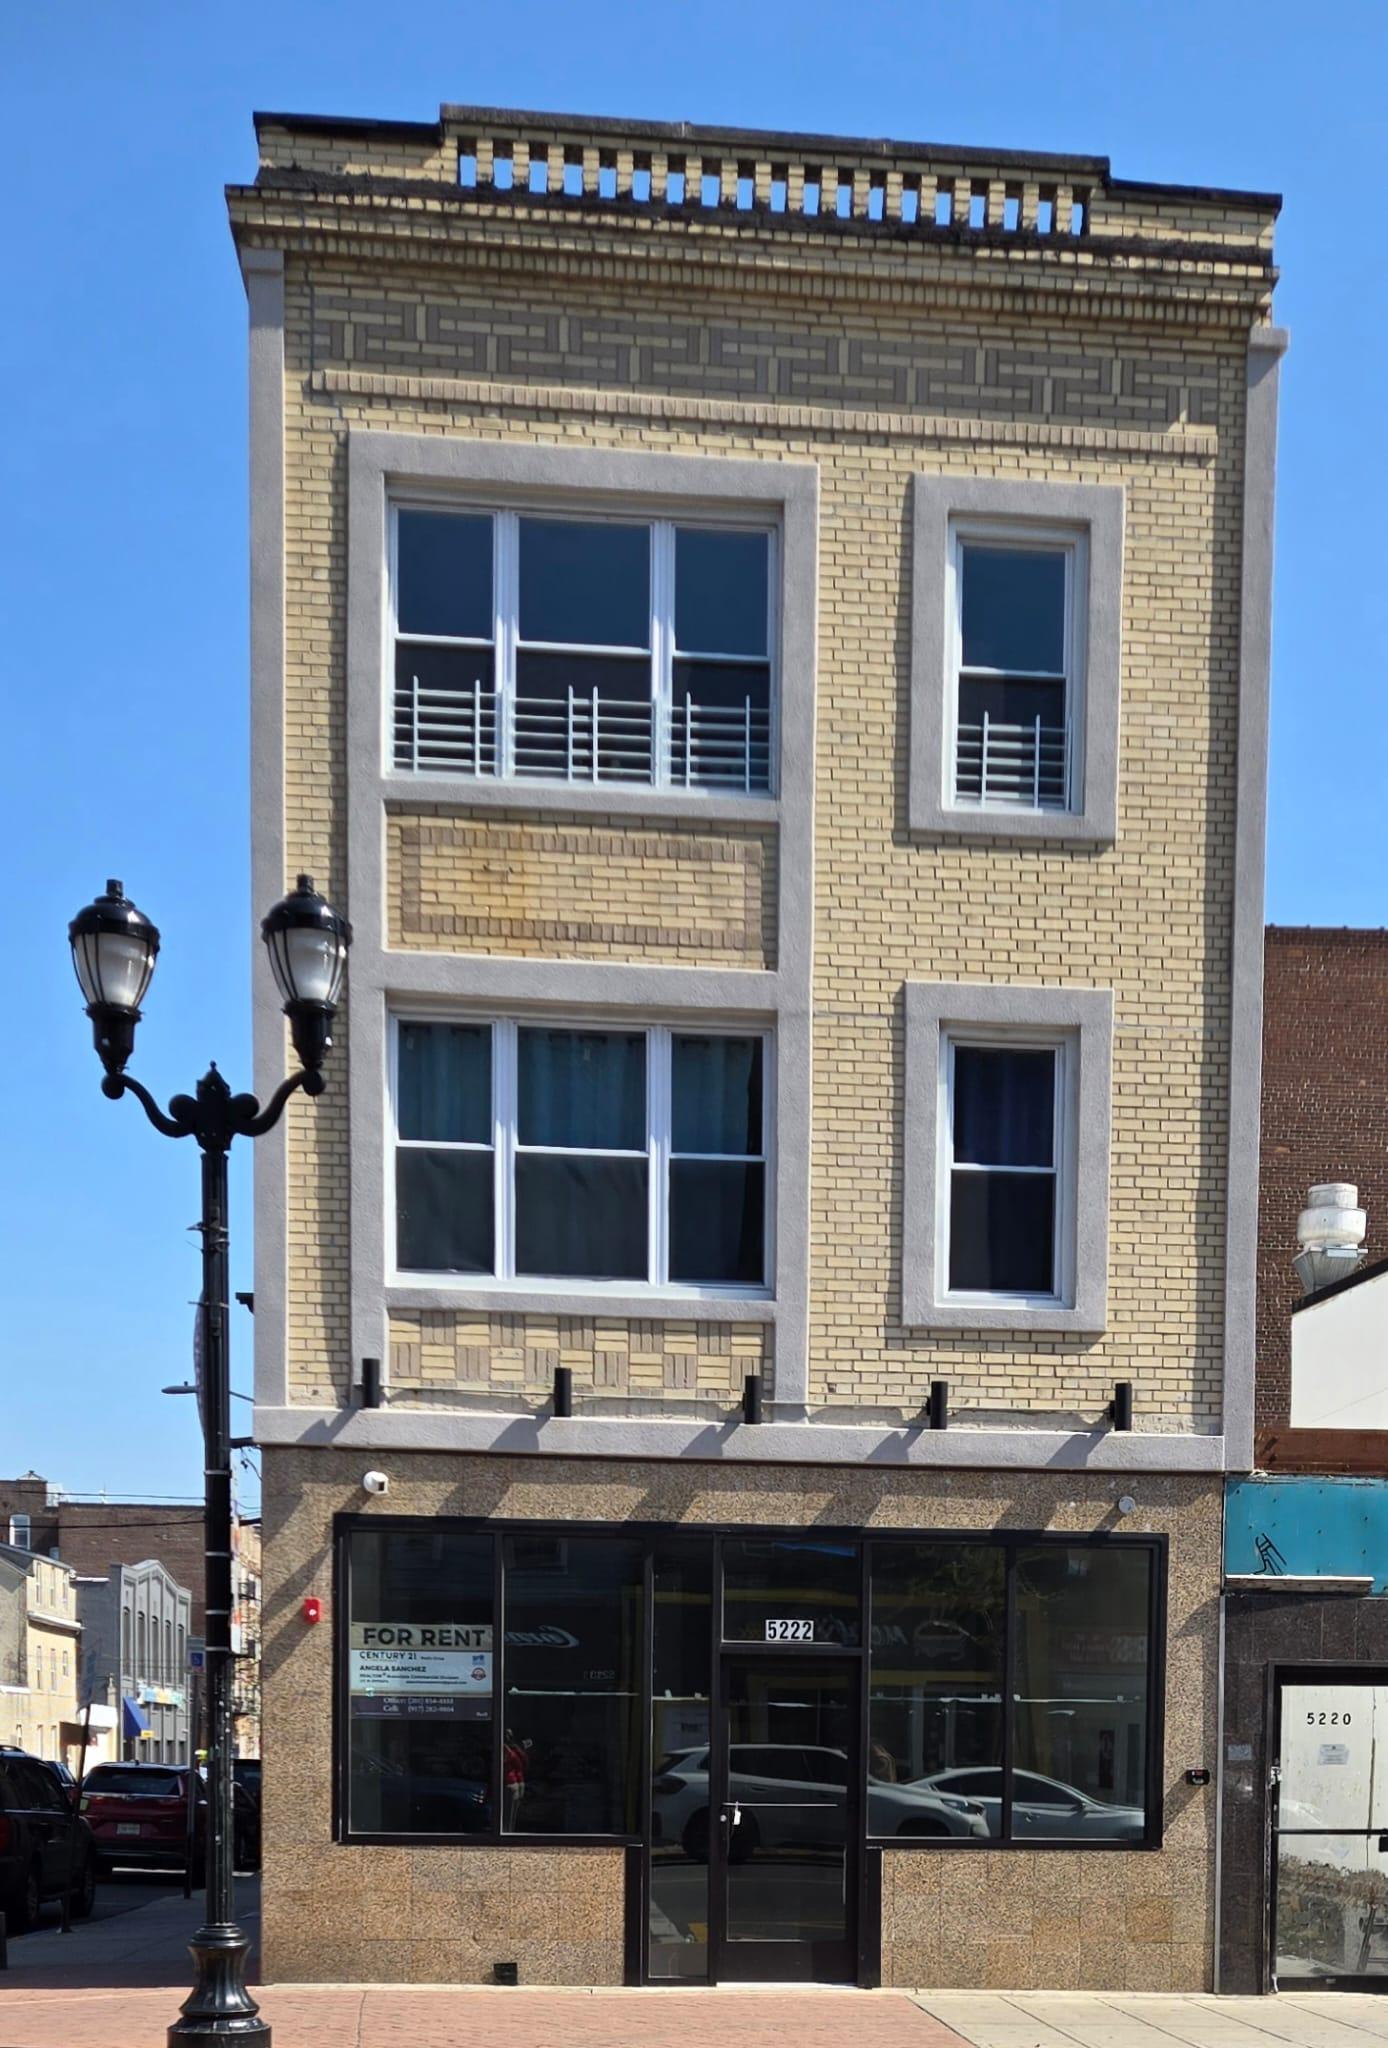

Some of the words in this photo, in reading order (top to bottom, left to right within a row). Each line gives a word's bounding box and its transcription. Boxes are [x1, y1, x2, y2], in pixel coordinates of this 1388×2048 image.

[768, 1621, 812, 1640] 5222
[363, 1628, 413, 1646] FOR
[421, 1628, 486, 1647] RENT
[360, 1651, 406, 1660] CENTURY
[408, 1652, 417, 1660] 21
[391, 1665, 427, 1673] SANCHEZ
[1306, 1712, 1352, 1725] 5220
